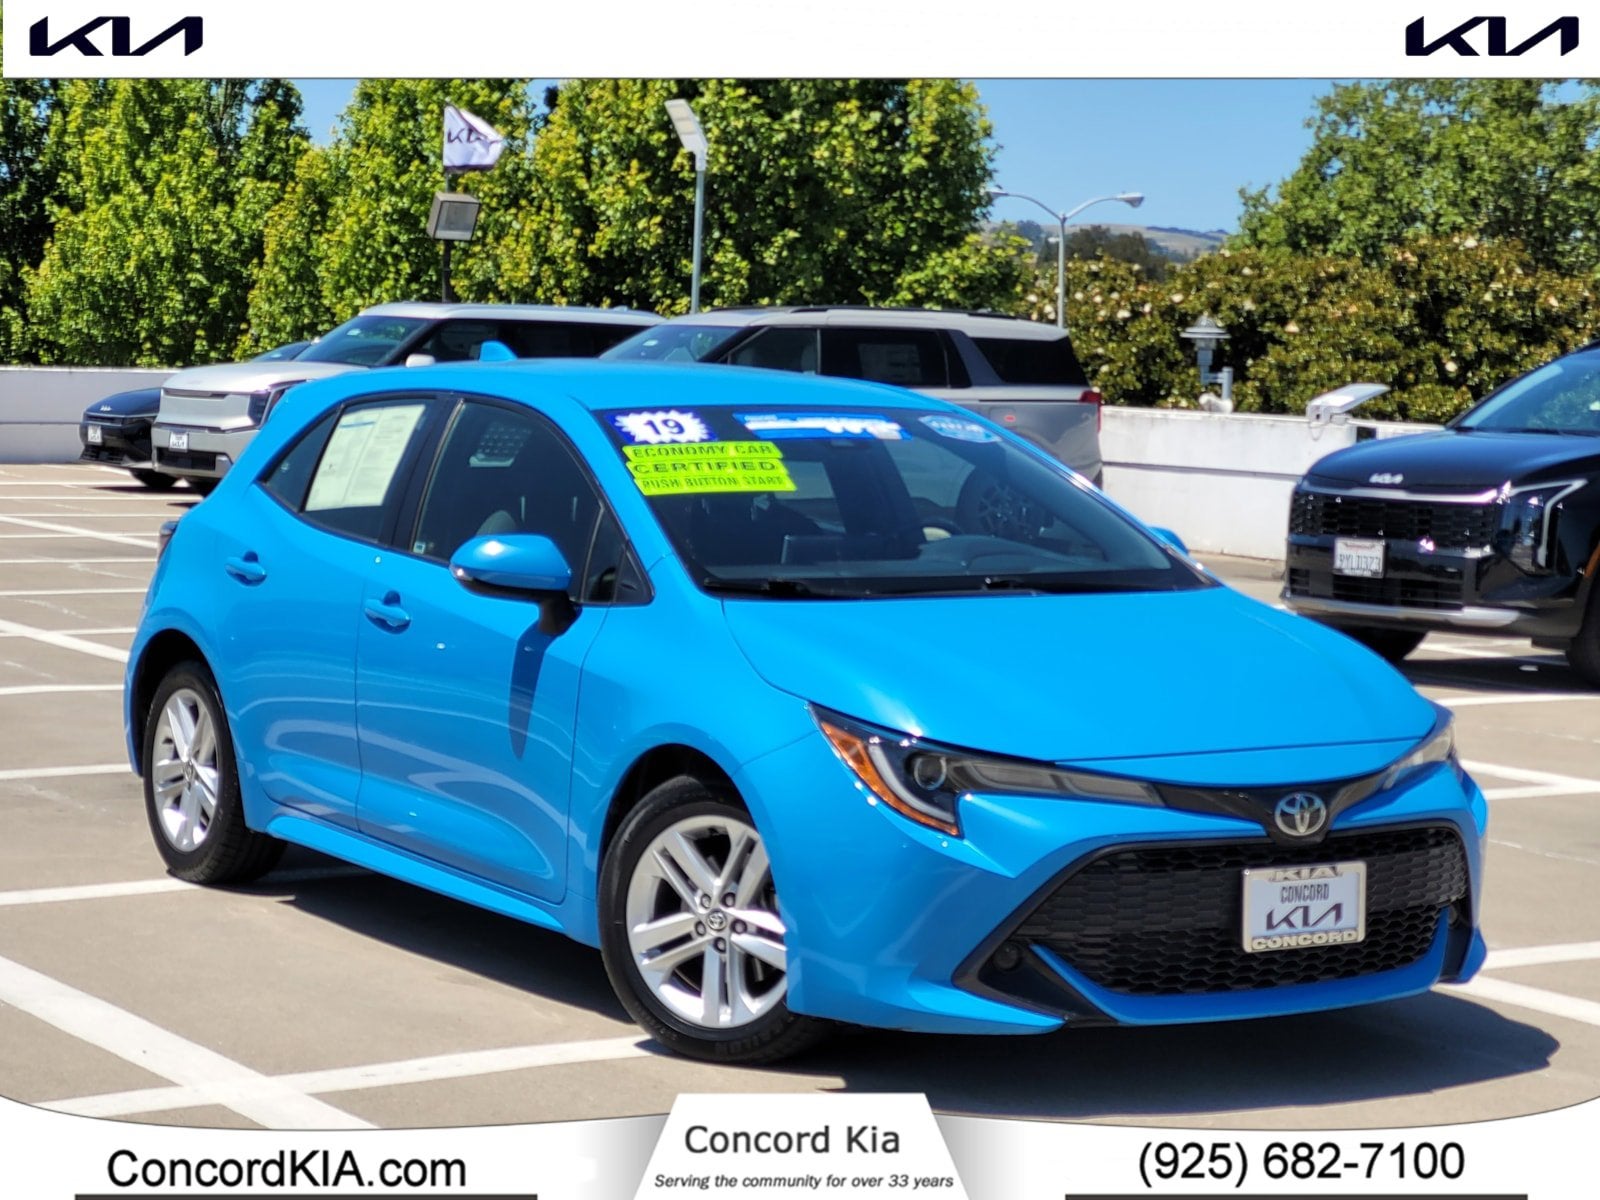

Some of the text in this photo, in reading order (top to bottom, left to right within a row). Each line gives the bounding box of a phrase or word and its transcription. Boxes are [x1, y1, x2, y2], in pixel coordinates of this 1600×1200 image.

[644, 418, 685, 435] 19
[633, 444, 773, 459] ECONOMY CAR
[634, 460, 776, 474] CERTIFIED
[642, 475, 784, 489] PUSH BUTTON START
[1275, 866, 1337, 882] KIA
[1280, 883, 1330, 904] CONCORD
[1266, 902, 1343, 931] KIA
[1252, 930, 1358, 950] CONCORD
